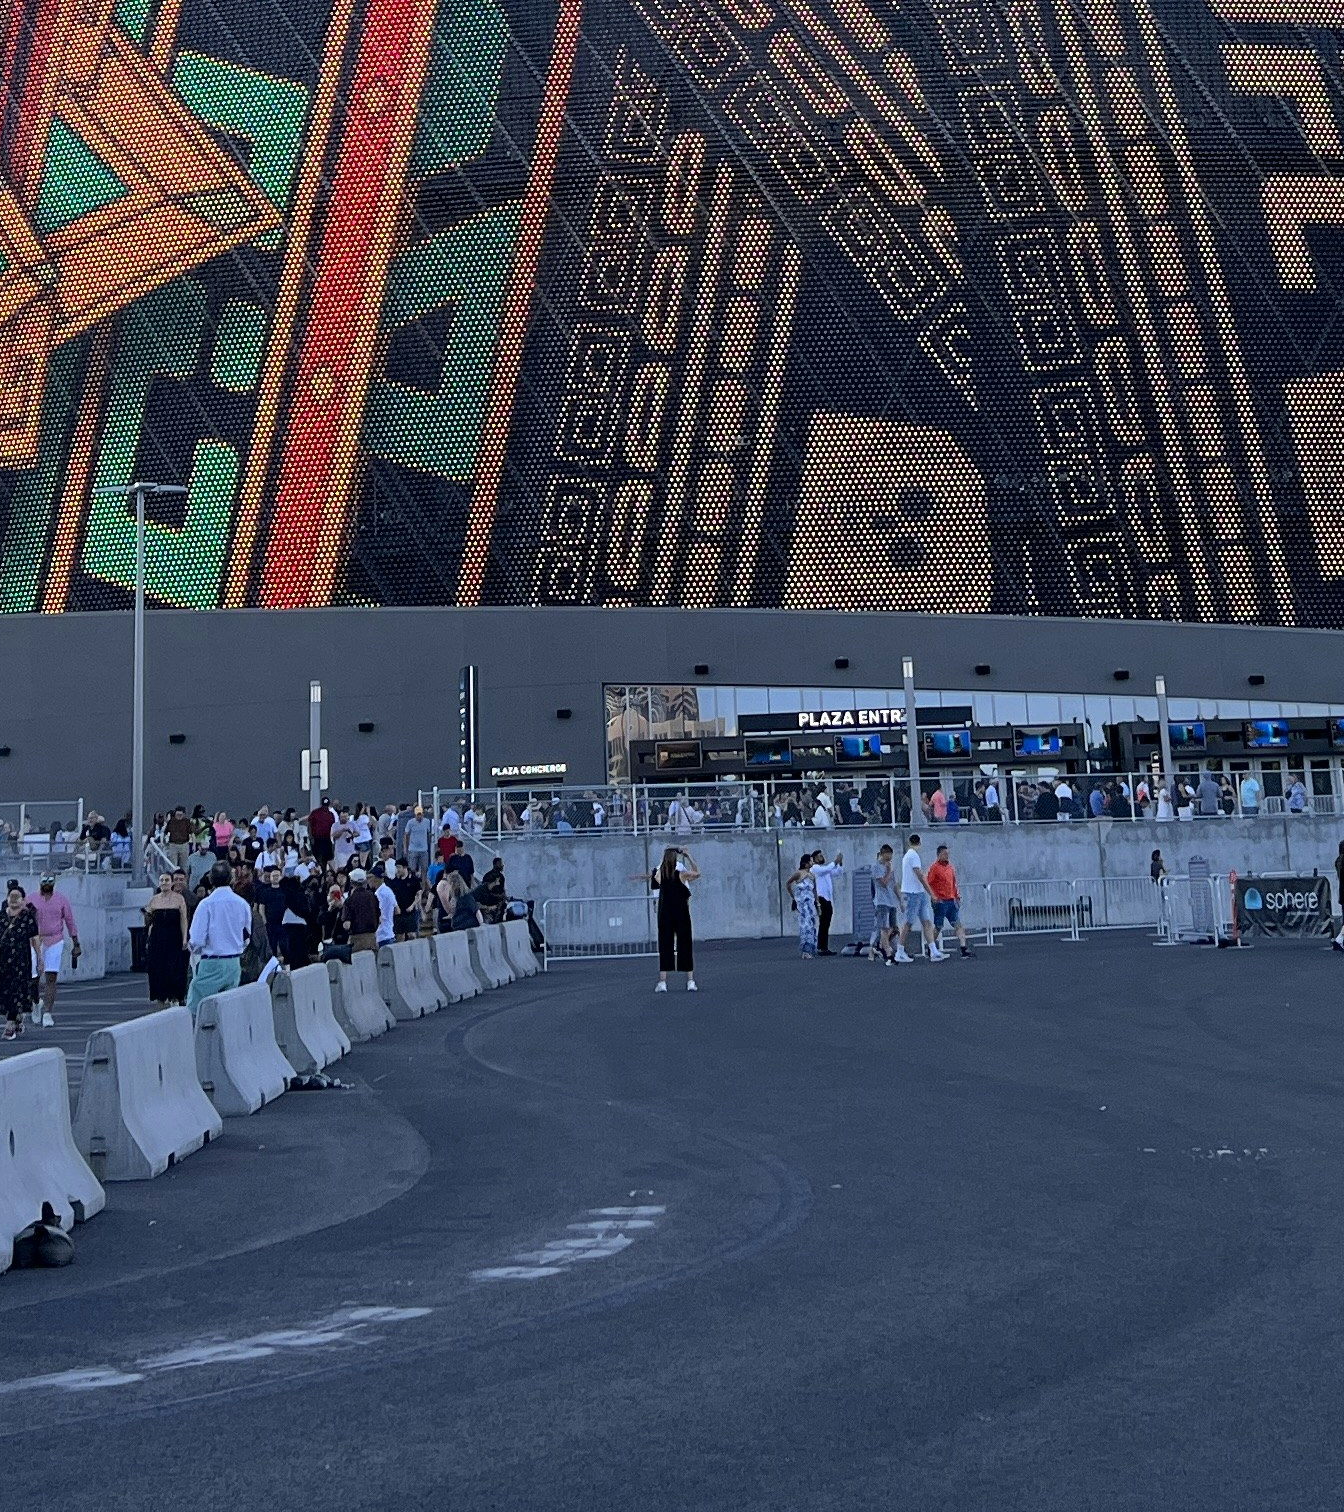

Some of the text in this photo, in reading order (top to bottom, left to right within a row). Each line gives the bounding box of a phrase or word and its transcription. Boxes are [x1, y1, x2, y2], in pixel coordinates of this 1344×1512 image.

[798, 708, 905, 727] PLAZA ENTR
[491, 763, 567, 776] PLAZA CONCIERGE
[1265, 888, 1319, 913] sphere
